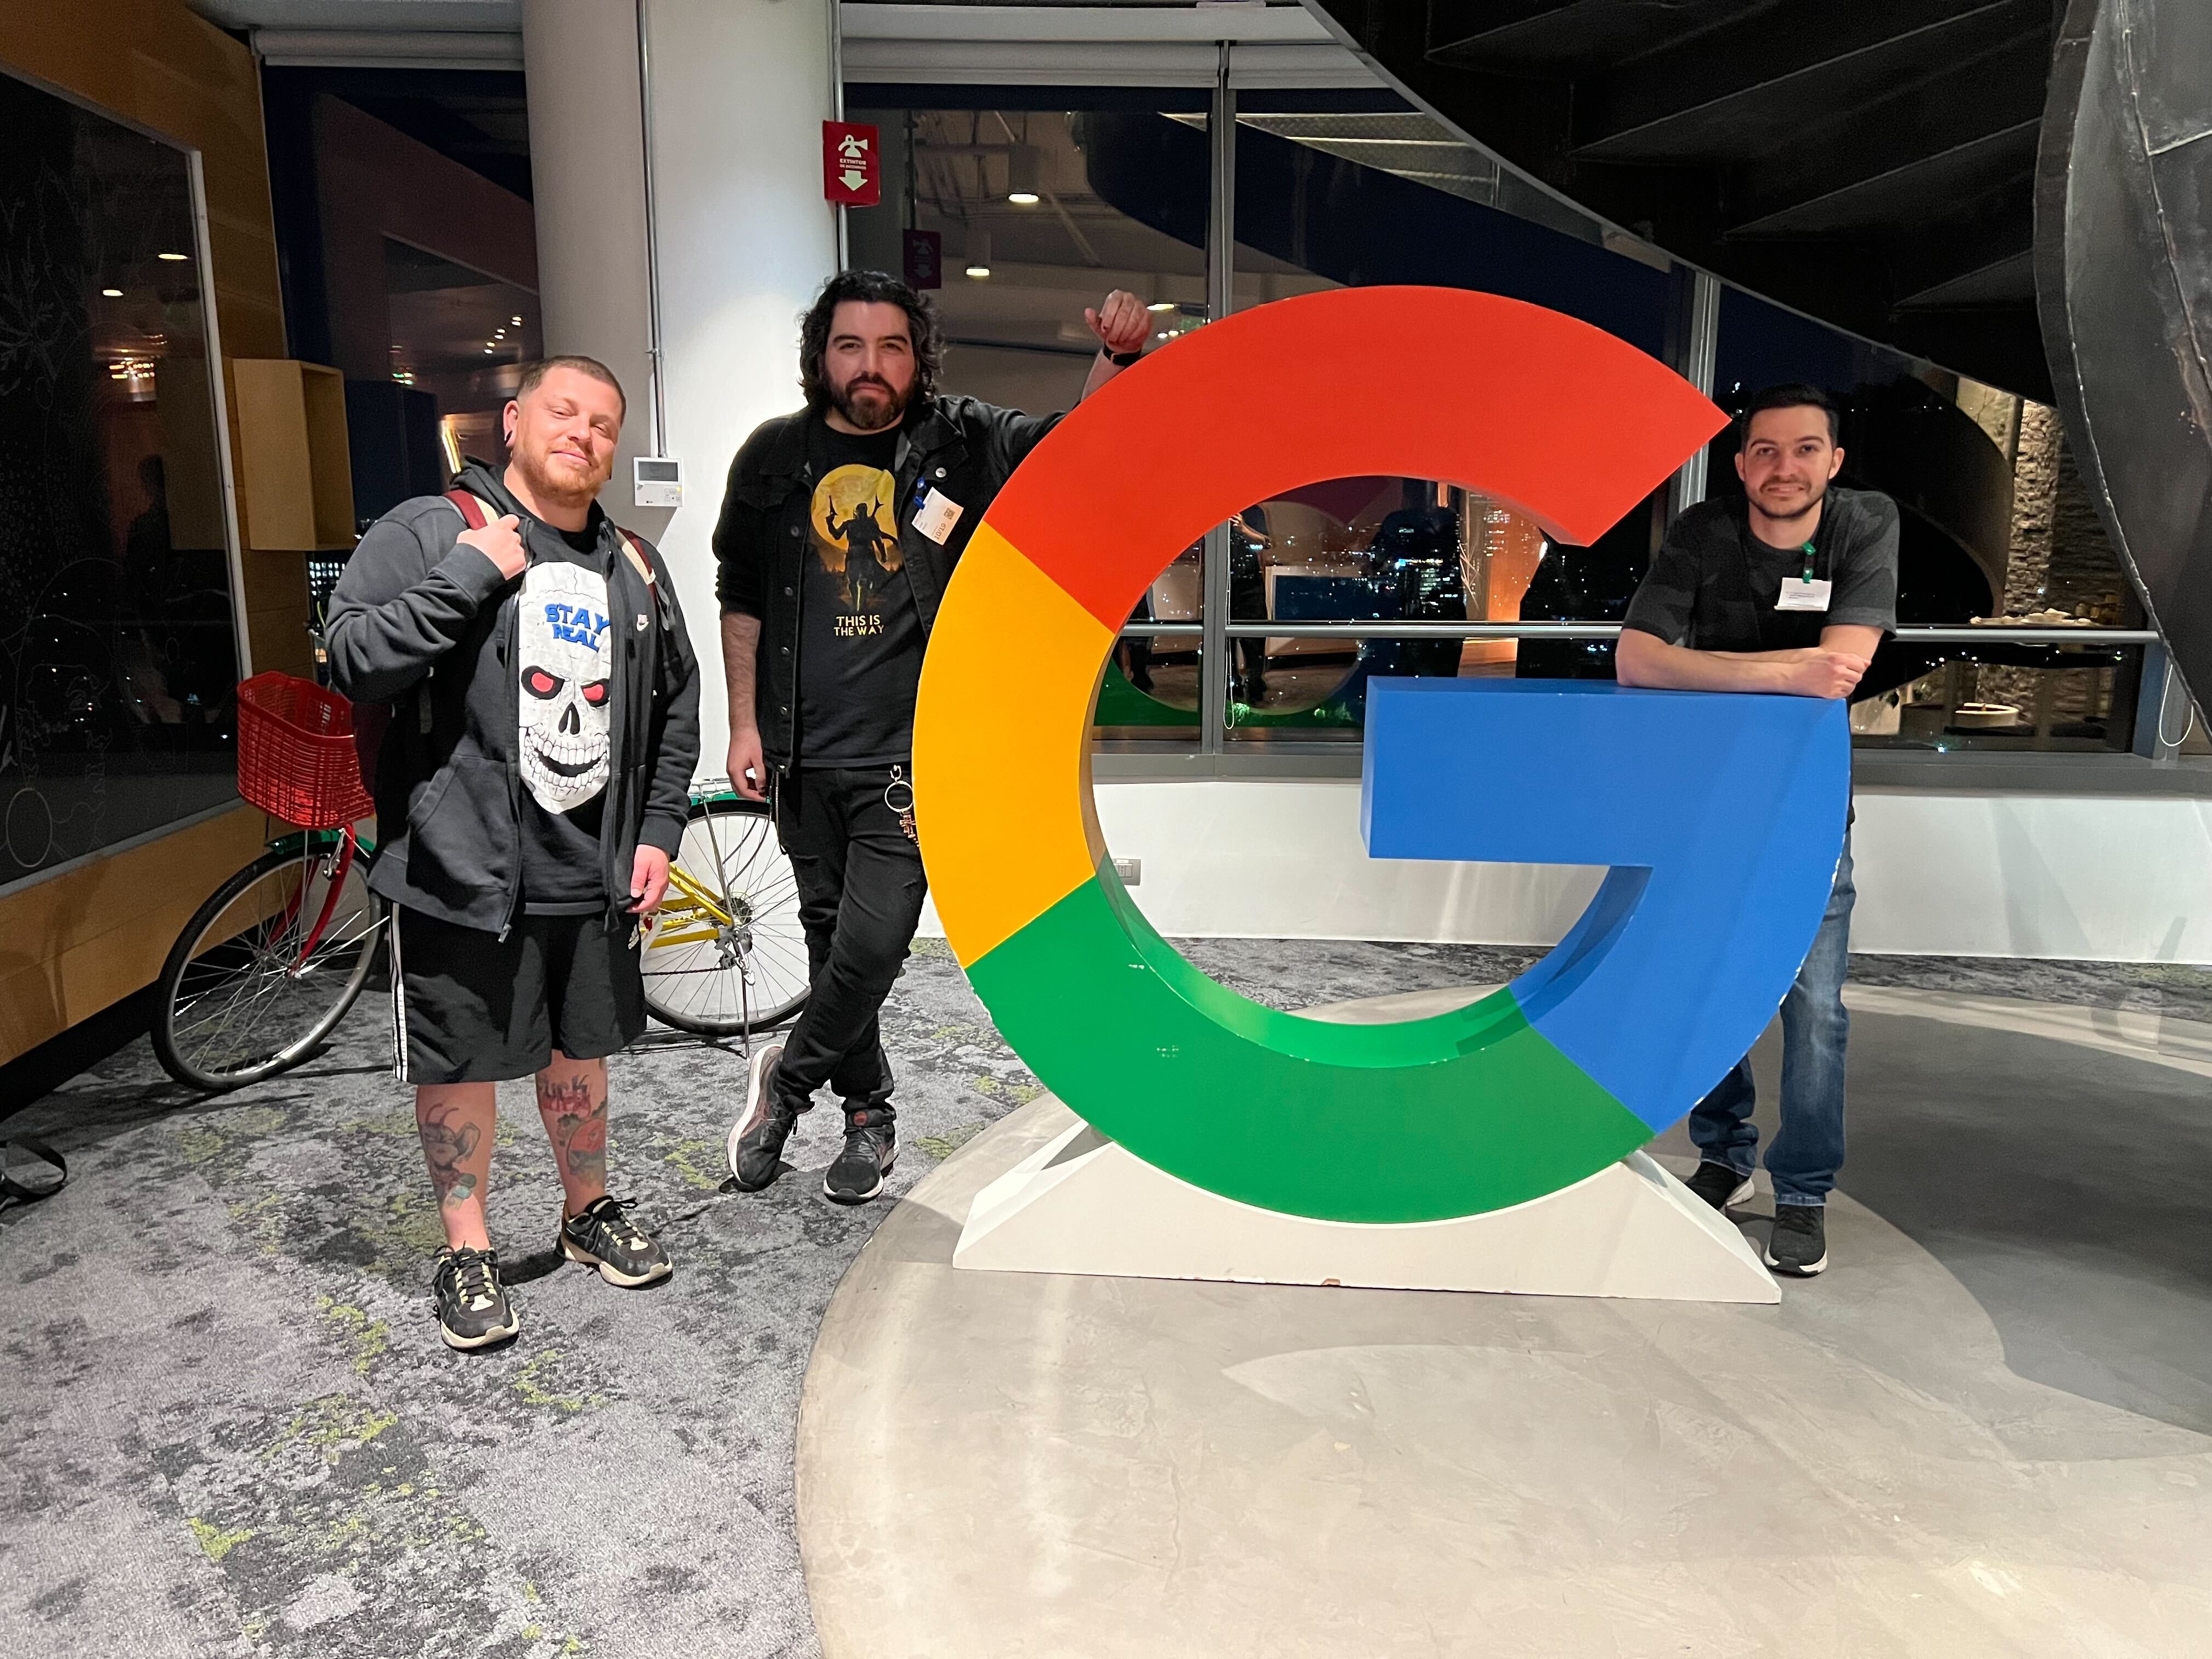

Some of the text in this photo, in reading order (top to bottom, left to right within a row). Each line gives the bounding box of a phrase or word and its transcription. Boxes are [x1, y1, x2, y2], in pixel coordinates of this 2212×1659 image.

[934, 523, 946, 540] 10/19
[544, 603, 611, 635] STAY
[836, 614, 881, 627] THIS IS
[552, 623, 600, 653] REAL
[834, 625, 885, 636] THE WAY
